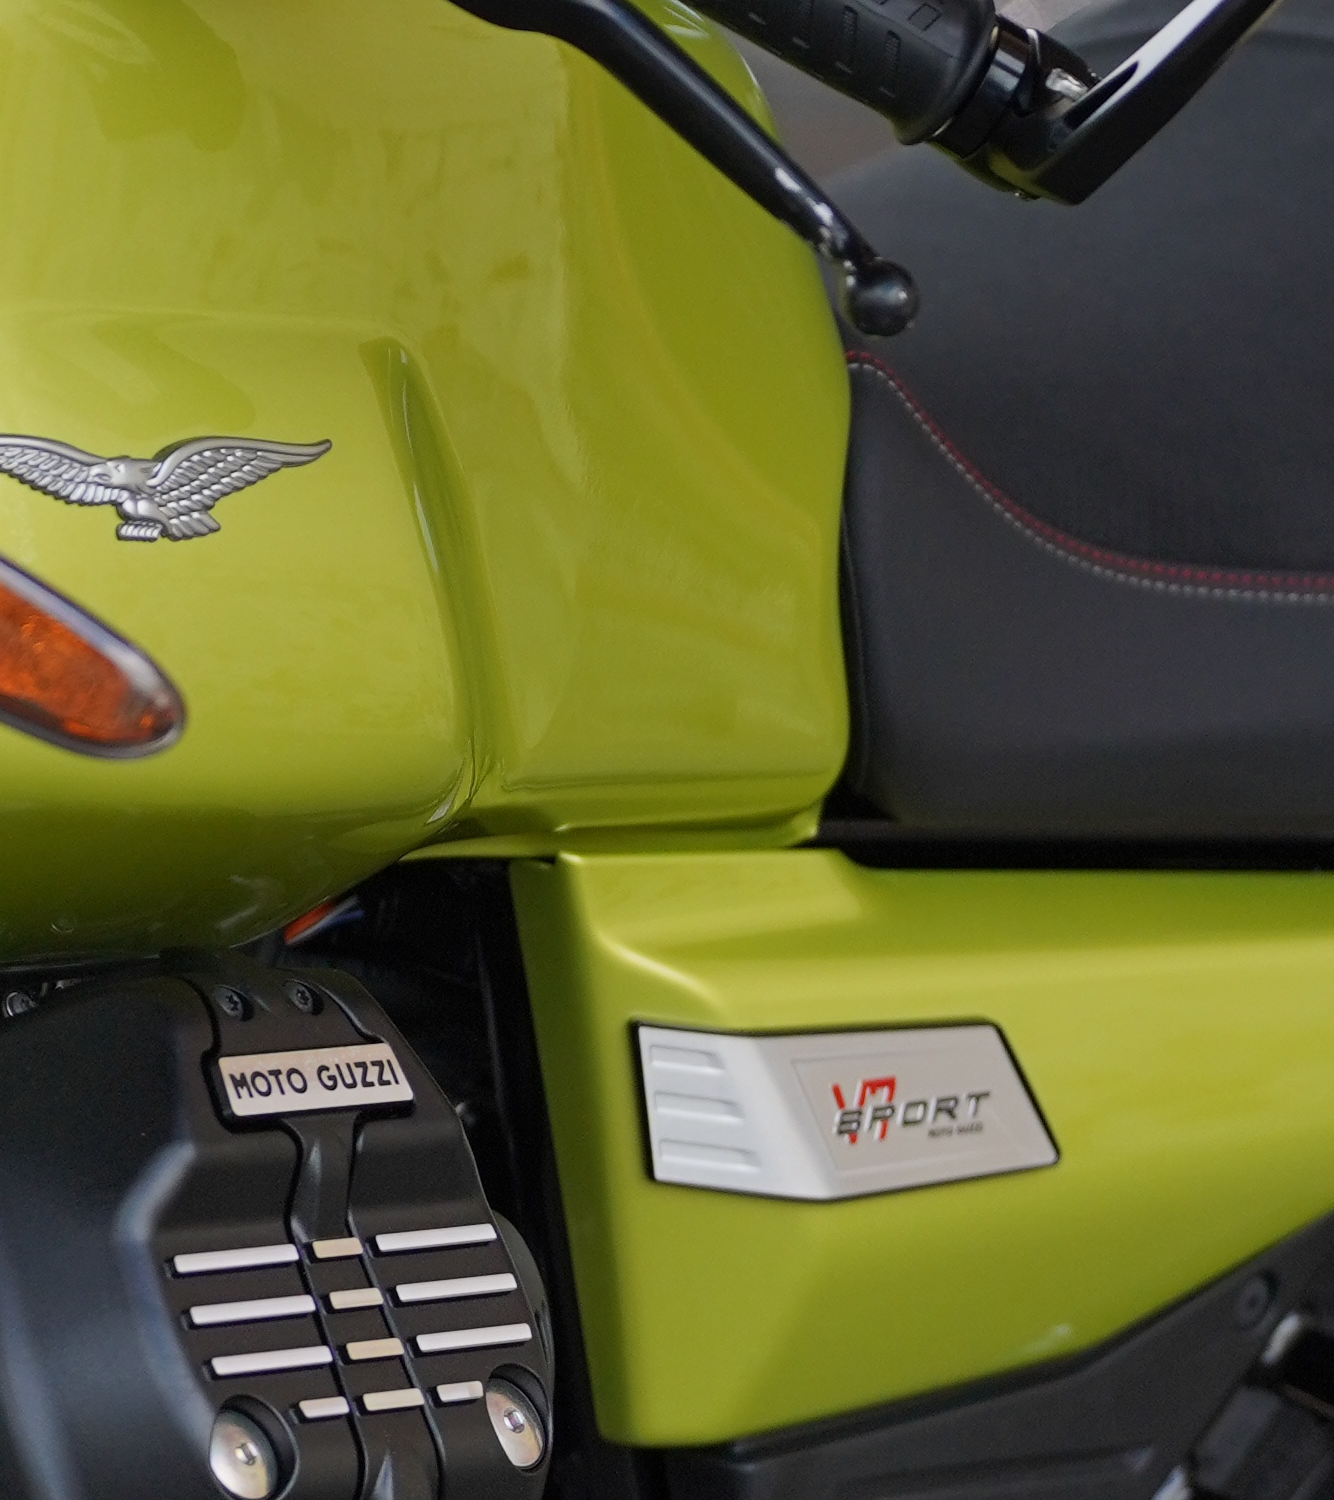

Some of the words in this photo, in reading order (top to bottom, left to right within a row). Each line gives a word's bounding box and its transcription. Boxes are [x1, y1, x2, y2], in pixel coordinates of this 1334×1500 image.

[230, 1068, 307, 1099] MOTO
[317, 1059, 400, 1091] GUZZI
[832, 1077, 895, 1144] V7
[835, 1091, 990, 1135] SPORT
